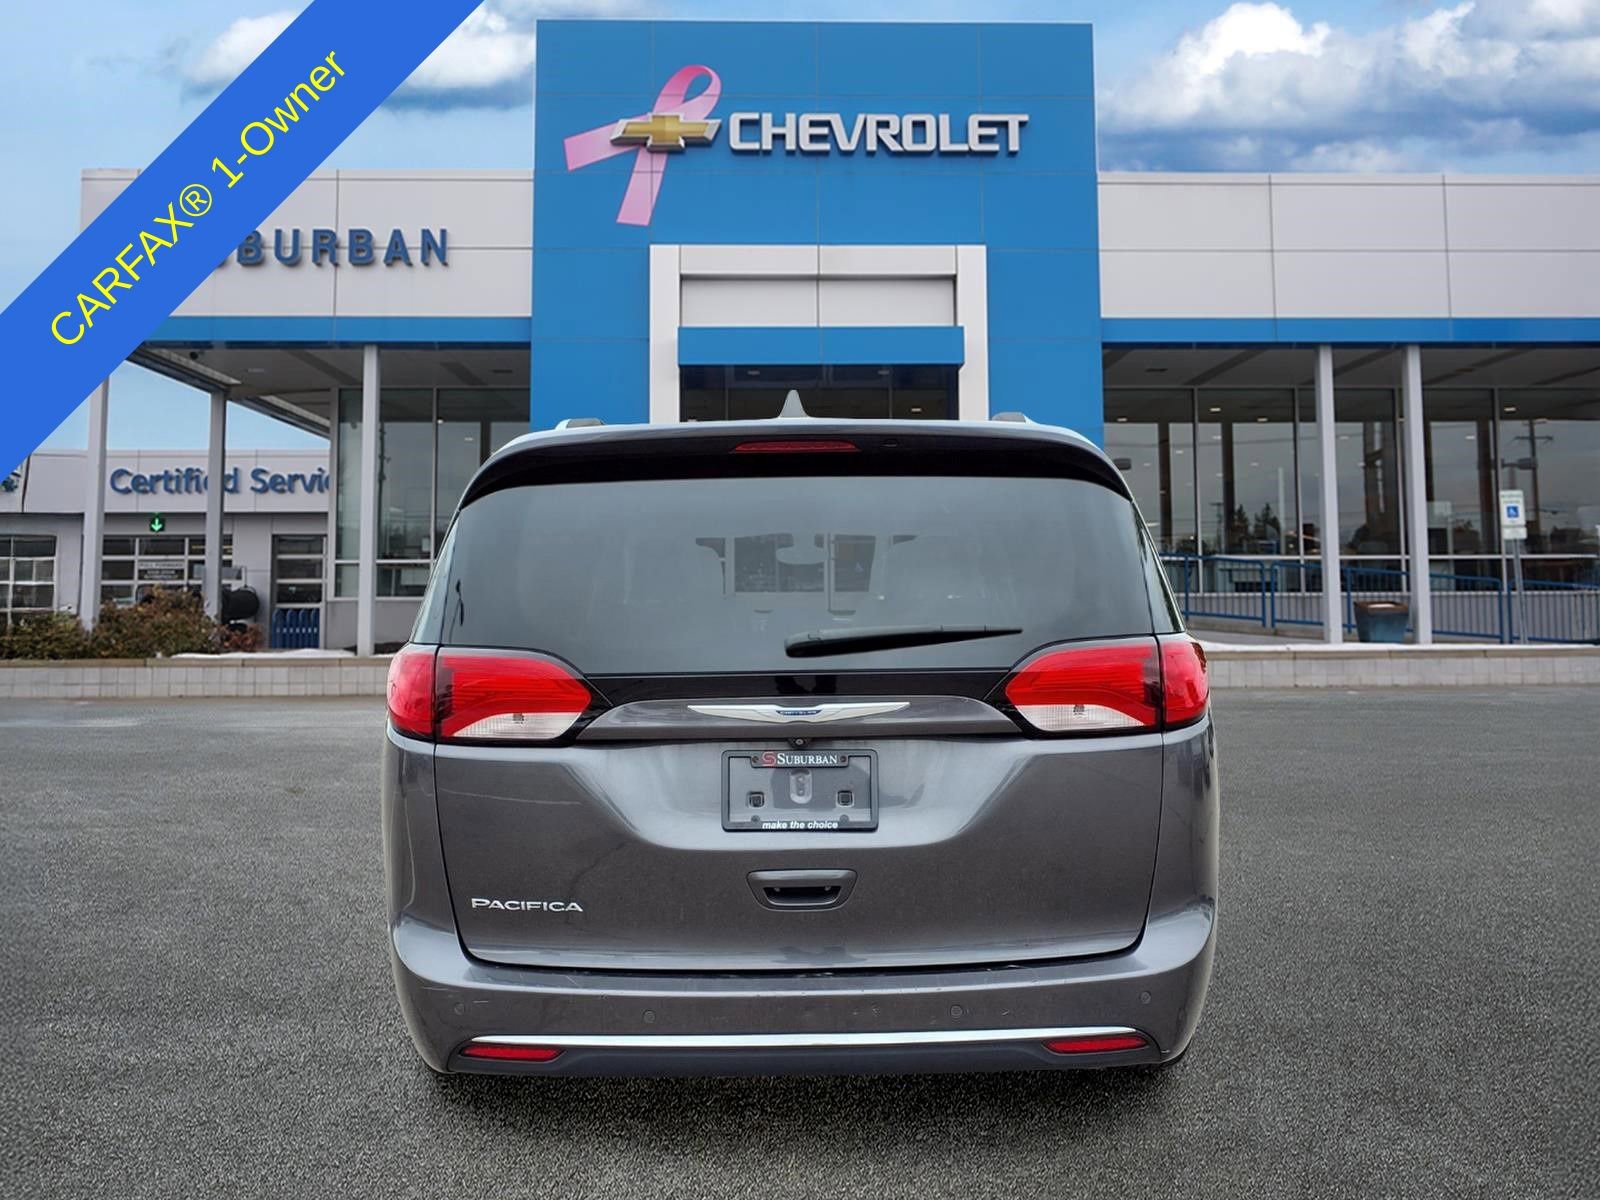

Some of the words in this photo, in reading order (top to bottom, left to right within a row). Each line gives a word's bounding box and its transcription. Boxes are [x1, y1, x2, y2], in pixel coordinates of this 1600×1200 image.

[729, 112, 1030, 154] CHEVROLET
[217, 228, 450, 267] BURBAN
[110, 467, 240, 494] Certifid
[762, 820, 788, 830] make
[789, 820, 806, 830] the
[807, 820, 839, 830] choice
[471, 898, 584, 912] PACIFICA
